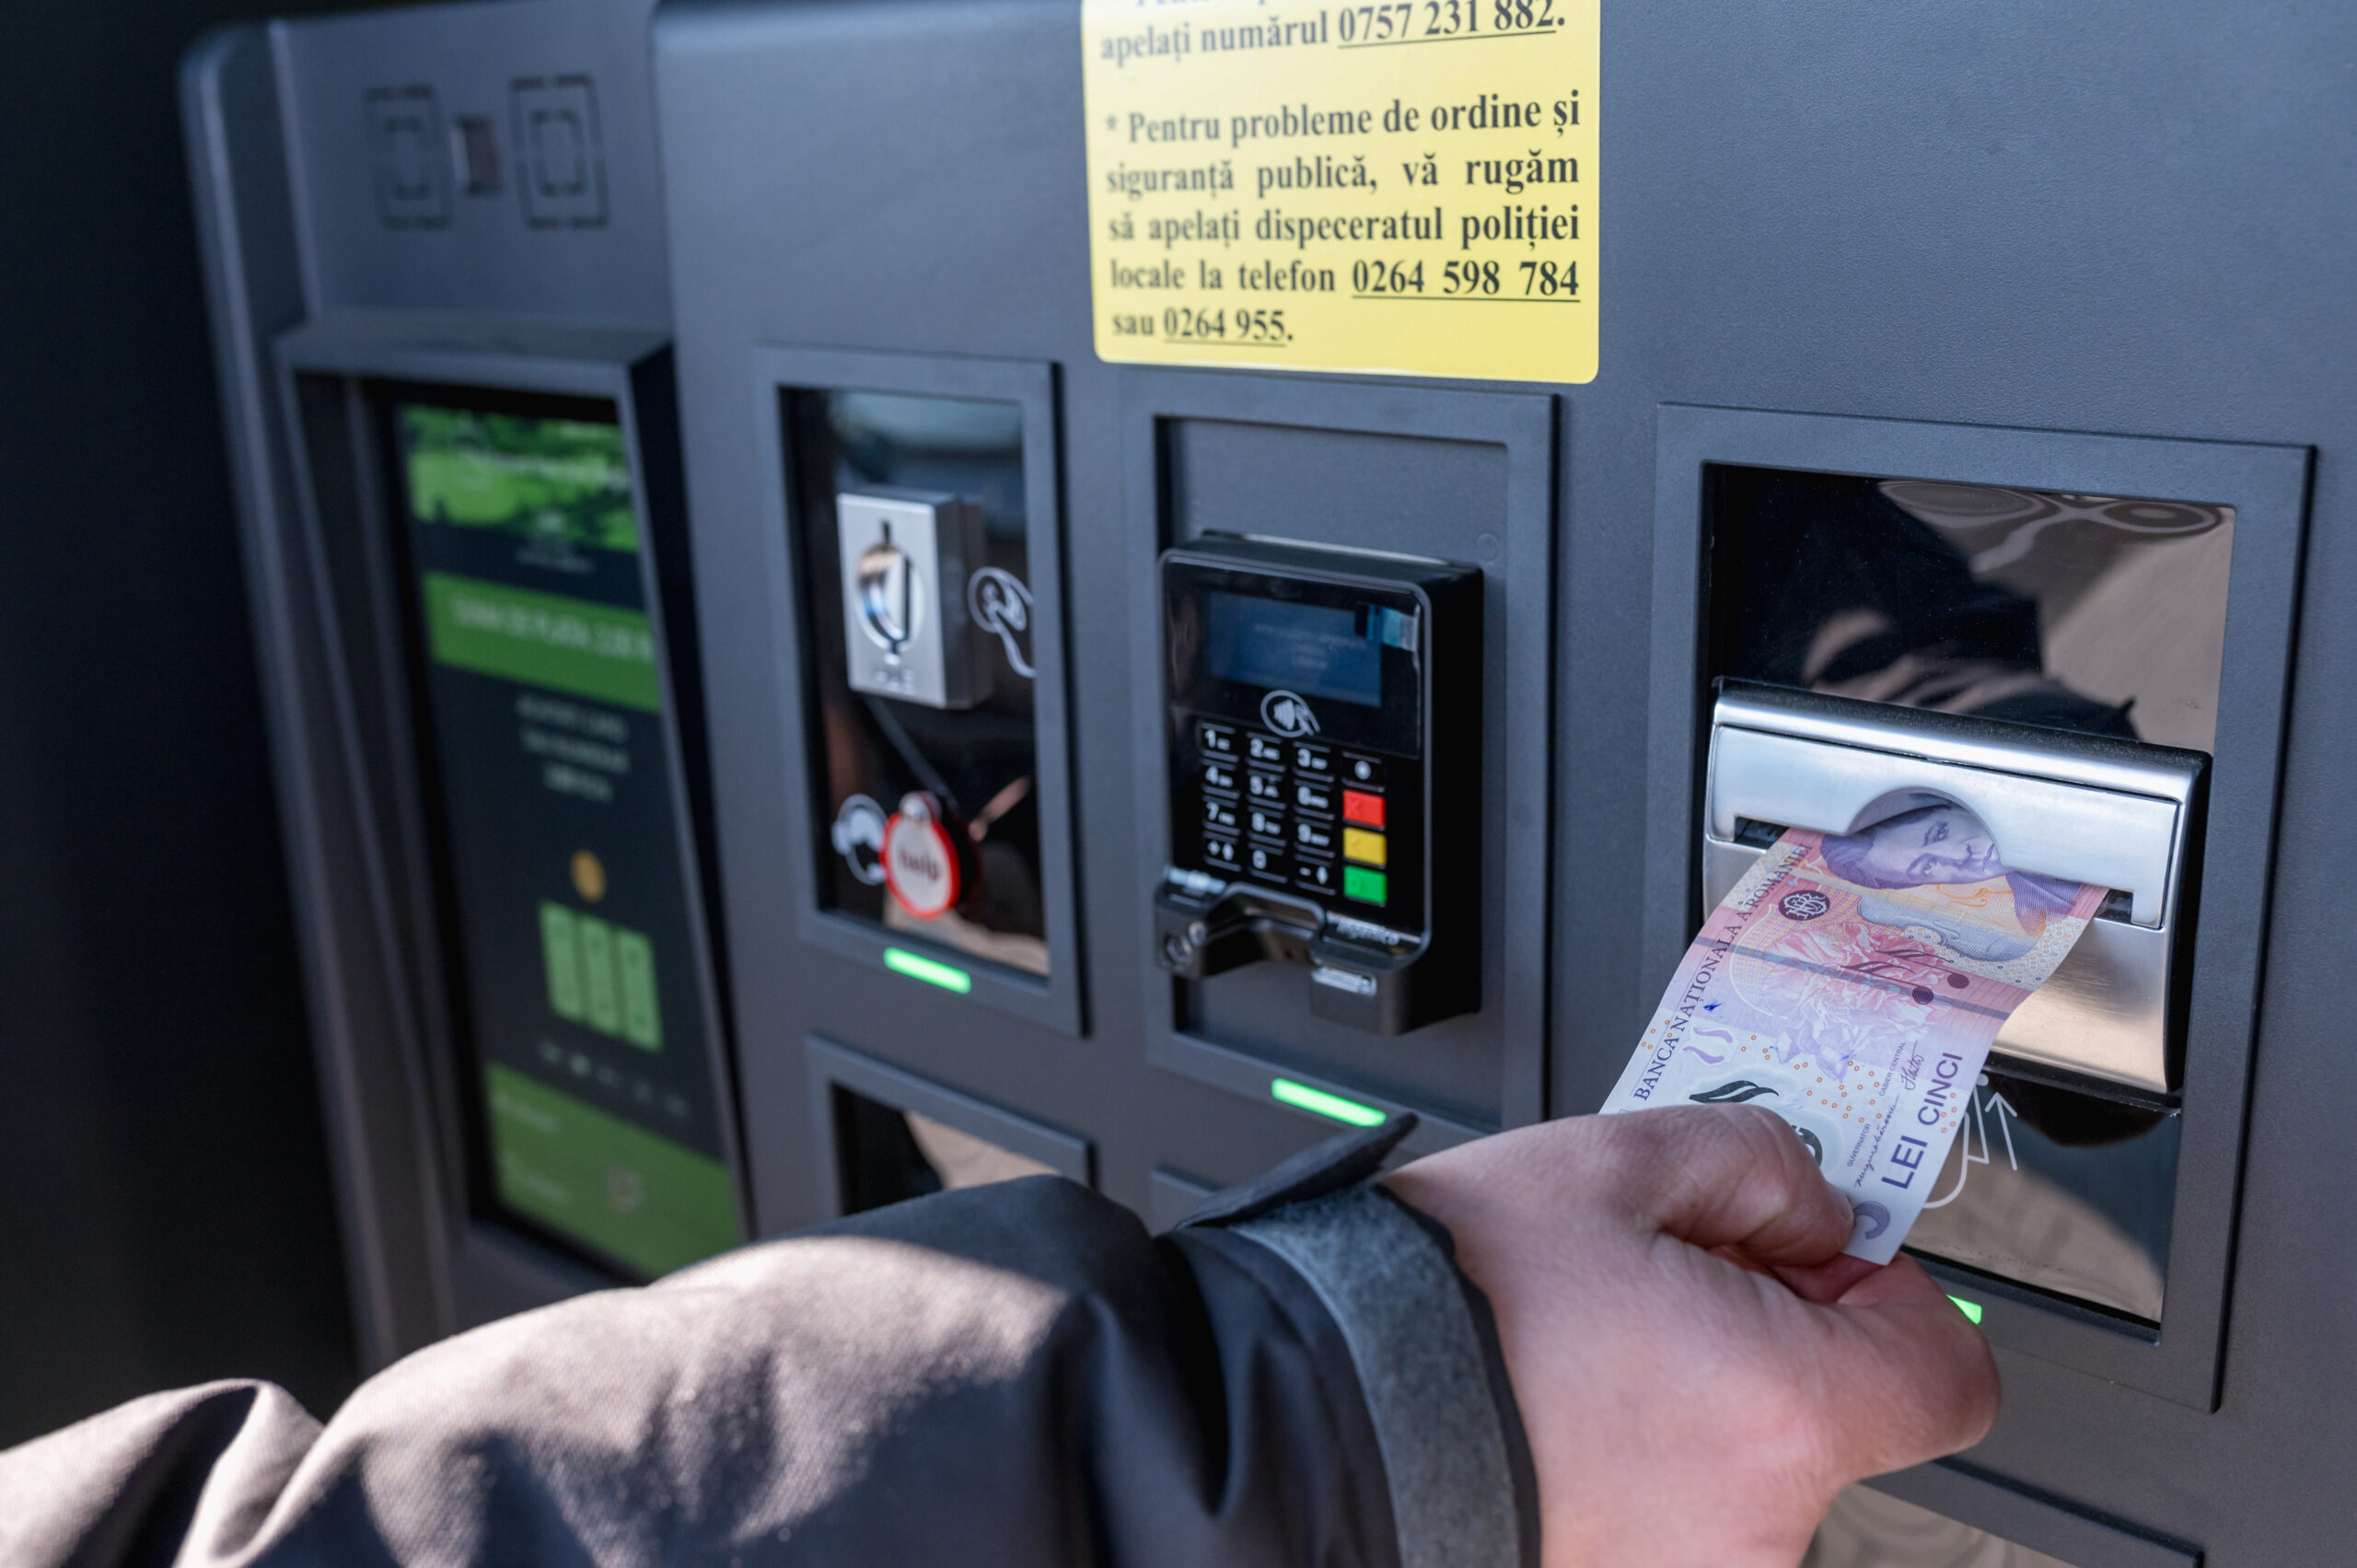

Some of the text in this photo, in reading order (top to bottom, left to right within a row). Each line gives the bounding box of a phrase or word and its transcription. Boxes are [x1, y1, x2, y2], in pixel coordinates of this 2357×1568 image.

[1101, 22, 1191, 68] apelați
[1201, 10, 1328, 52] numărul
[1339, 3, 1412, 42] 0757
[1424, 0, 1479, 35] 231
[1129, 89, 1580, 148] Pentru probleme de ordine și
[1107, 148, 1579, 201] siguranță publică, vă rugăm
[1109, 204, 1580, 250] să apelați dispeceratul poliției
[1111, 259, 1579, 296] locale la telefon 0264 598 784
[1112, 307, 1294, 342] sau 0264 955.
[1632, 1036, 1680, 1101] BANCA
[1889, 1041, 1906, 1072] CENTRAL
[1847, 1123, 1872, 1167] GUVERNATOR
[1881, 1135, 1928, 1190] LEI
[1918, 1052, 1963, 1126] CINCI
